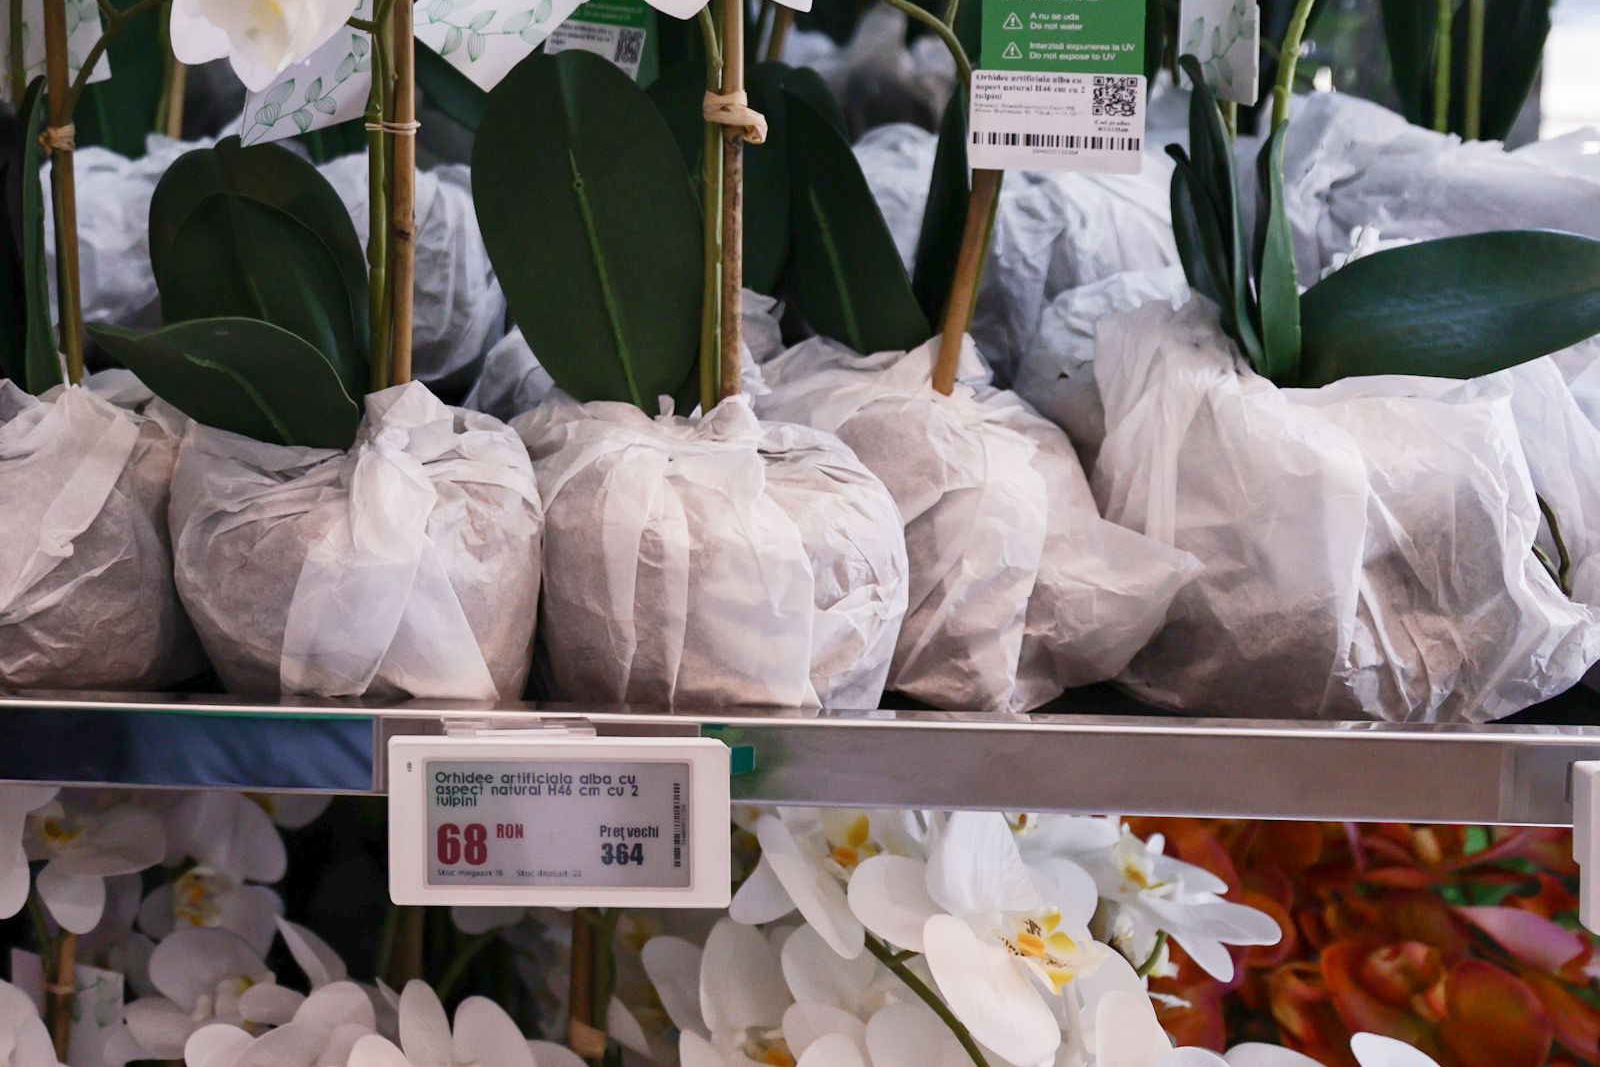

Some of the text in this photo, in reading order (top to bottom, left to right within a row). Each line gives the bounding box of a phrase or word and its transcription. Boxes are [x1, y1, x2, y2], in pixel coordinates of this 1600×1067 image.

[1030, 12, 1037, 20] A
[1030, 22, 1043, 30] Do
[1121, 43, 1135, 51] UV
[1029, 51, 1042, 59] Do
[1058, 53, 1090, 61] expose
[1102, 53, 1116, 61] UV
[435, 771, 636, 785] Orhidee artificiala alba cu
[435, 783, 639, 796] aspect natural H46 cm cu 2
[436, 795, 477, 808] tulpini
[626, 825, 659, 838] vechi
[437, 823, 524, 865] 68 RON
[601, 842, 644, 866] 364
[437, 869, 455, 877] Stoc
[516, 869, 534, 877] Stoc
